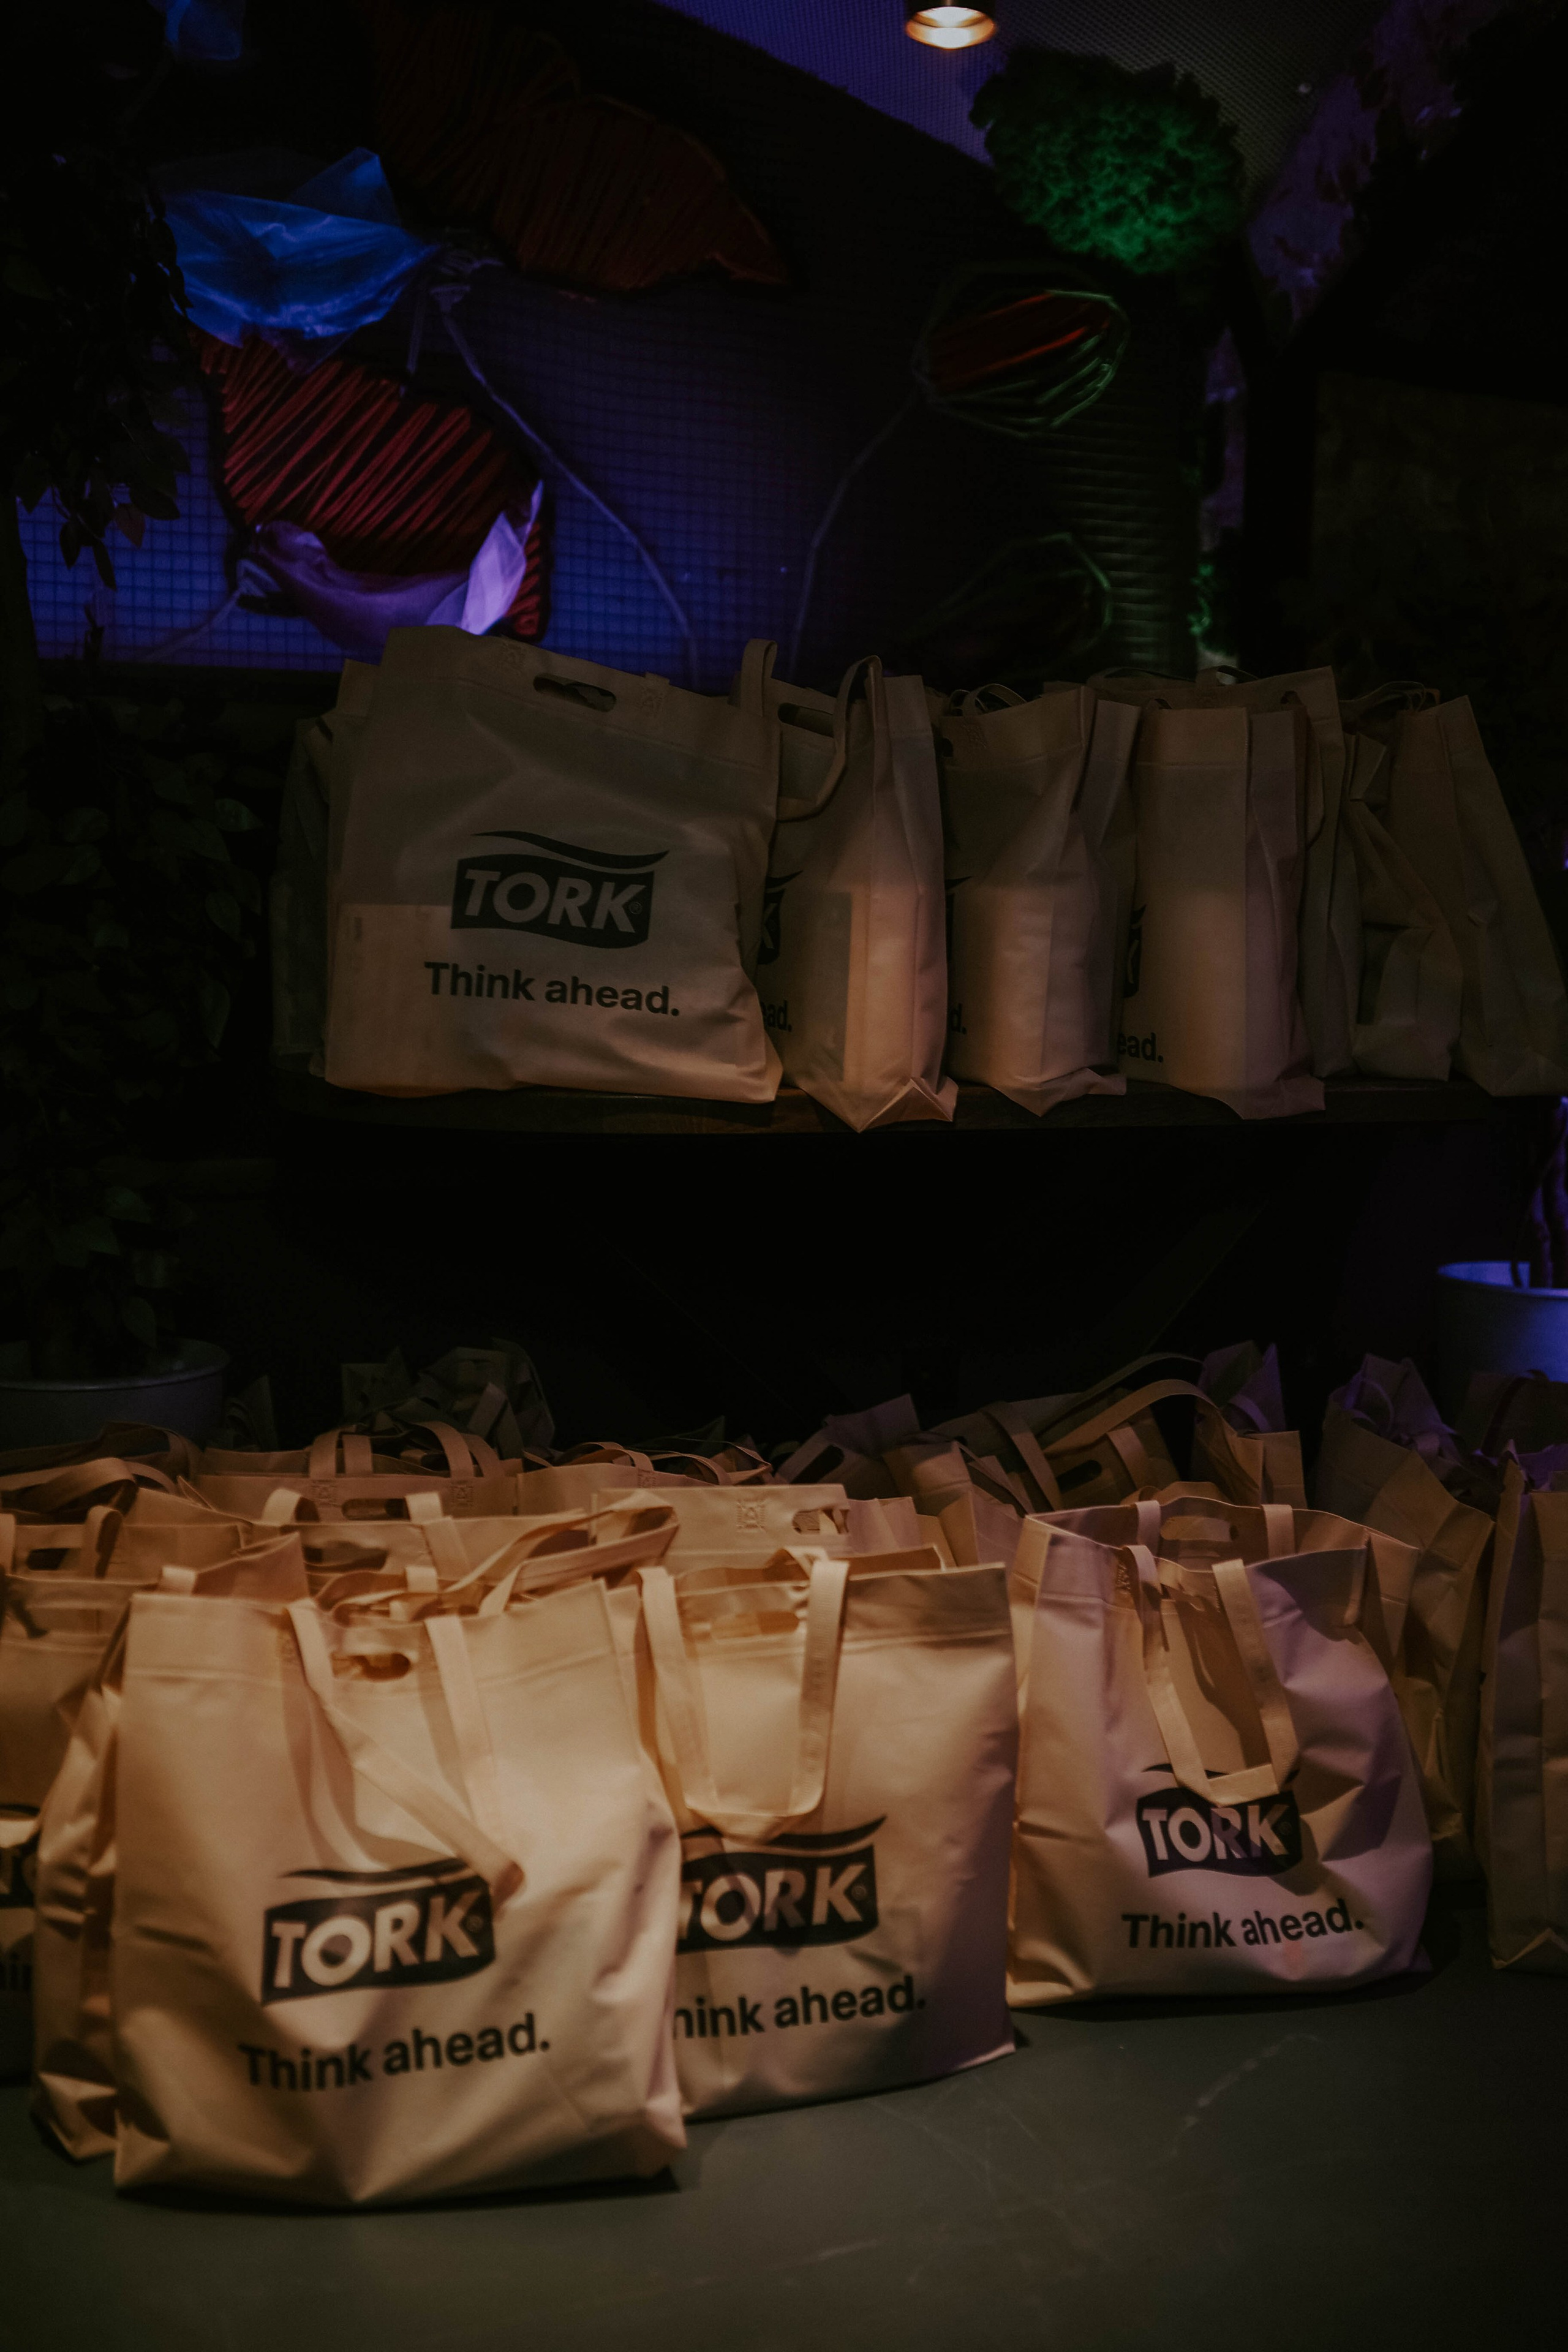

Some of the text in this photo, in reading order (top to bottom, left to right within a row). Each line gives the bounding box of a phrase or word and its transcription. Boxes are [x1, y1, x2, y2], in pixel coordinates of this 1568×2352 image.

[463, 868, 647, 933] TORK
[424, 960, 680, 1017] Think ahead.
[1142, 1803, 1291, 1863] TORK
[270, 1890, 483, 1989] TORK
[1121, 1898, 1365, 1948] Think ahead.
[774, 1974, 926, 2029] ahead.
[237, 2011, 550, 2092] Think ahead.
